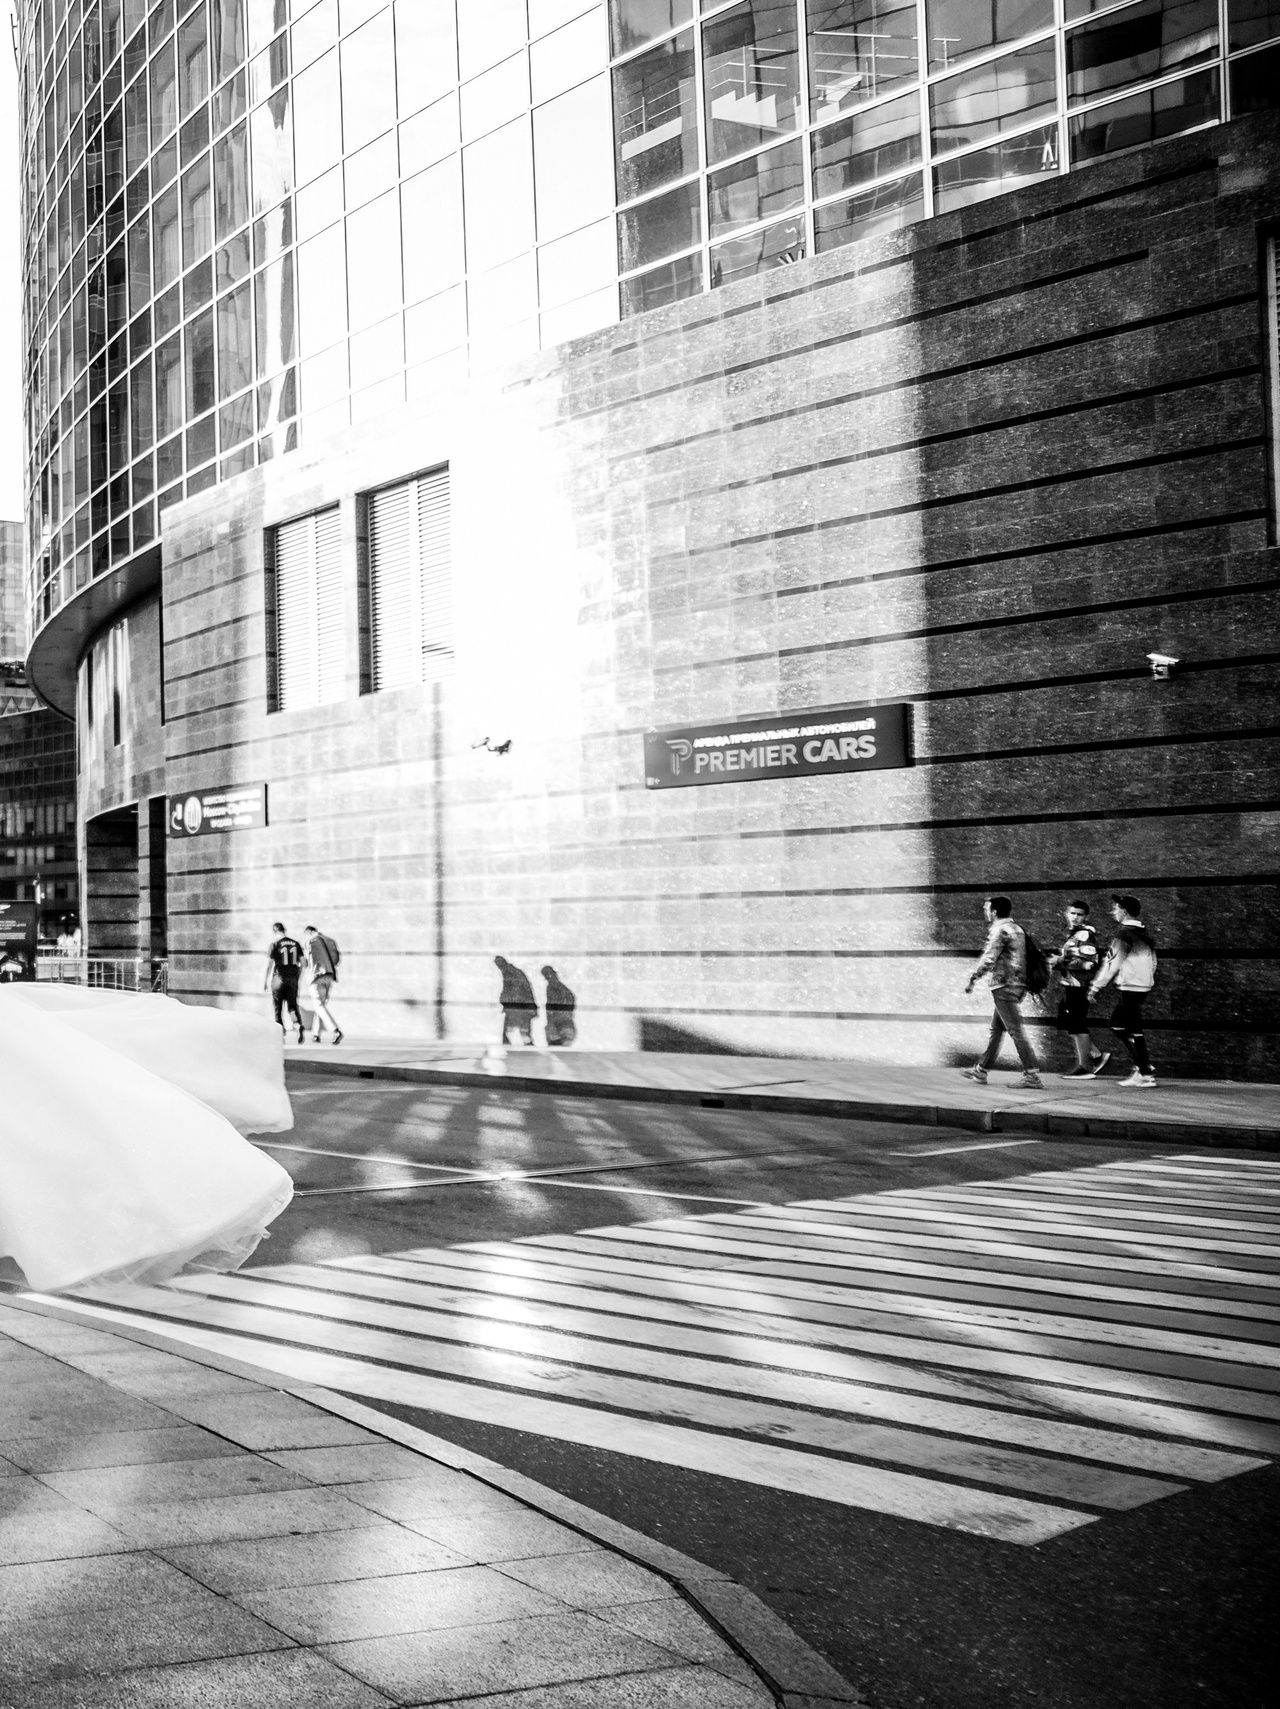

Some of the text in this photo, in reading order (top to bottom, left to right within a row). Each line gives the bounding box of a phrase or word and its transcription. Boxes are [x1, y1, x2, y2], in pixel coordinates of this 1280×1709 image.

[800, 717, 876, 737] АВТОМОБИЛЕЙ
[694, 735, 877, 774] PREMIER CARS
[280, 946, 297, 965] 11
